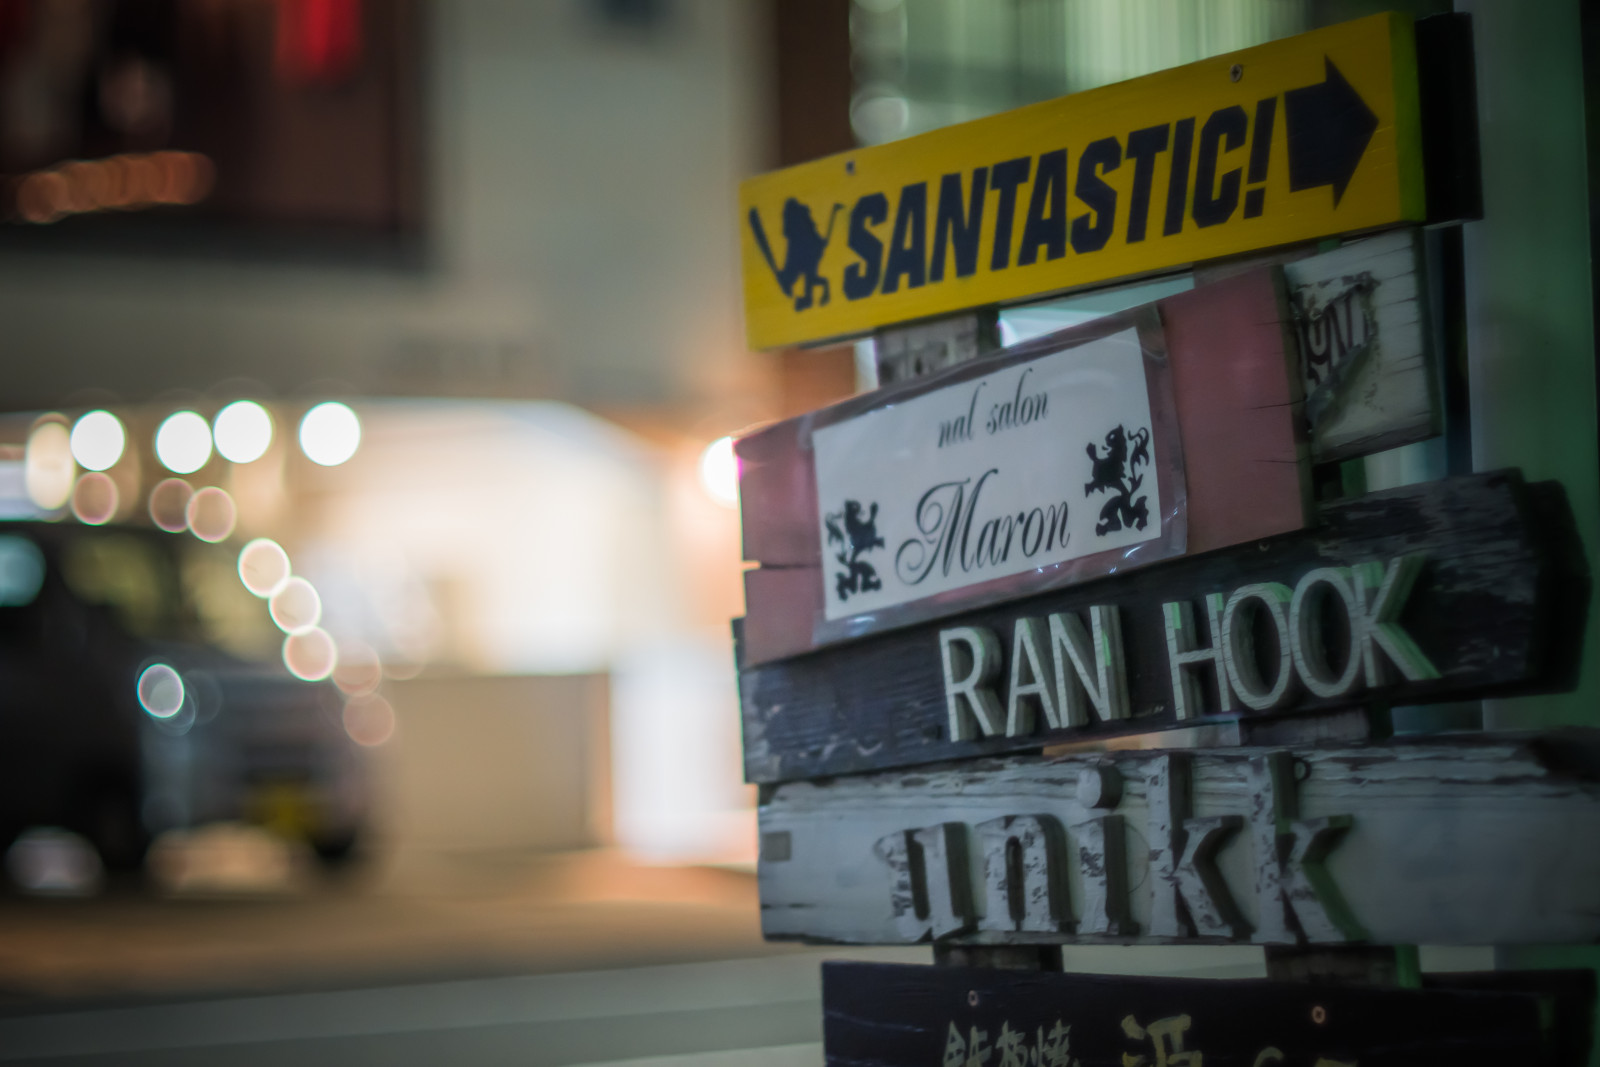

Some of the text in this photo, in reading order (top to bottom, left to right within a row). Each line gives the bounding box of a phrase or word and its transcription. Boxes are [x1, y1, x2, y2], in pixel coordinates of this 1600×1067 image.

[842, 96, 1277, 301] SANTASTIC!
[938, 367, 1048, 448] nal salon
[895, 468, 1070, 586] Maron
[938, 554, 1442, 742] RAN HOOK
